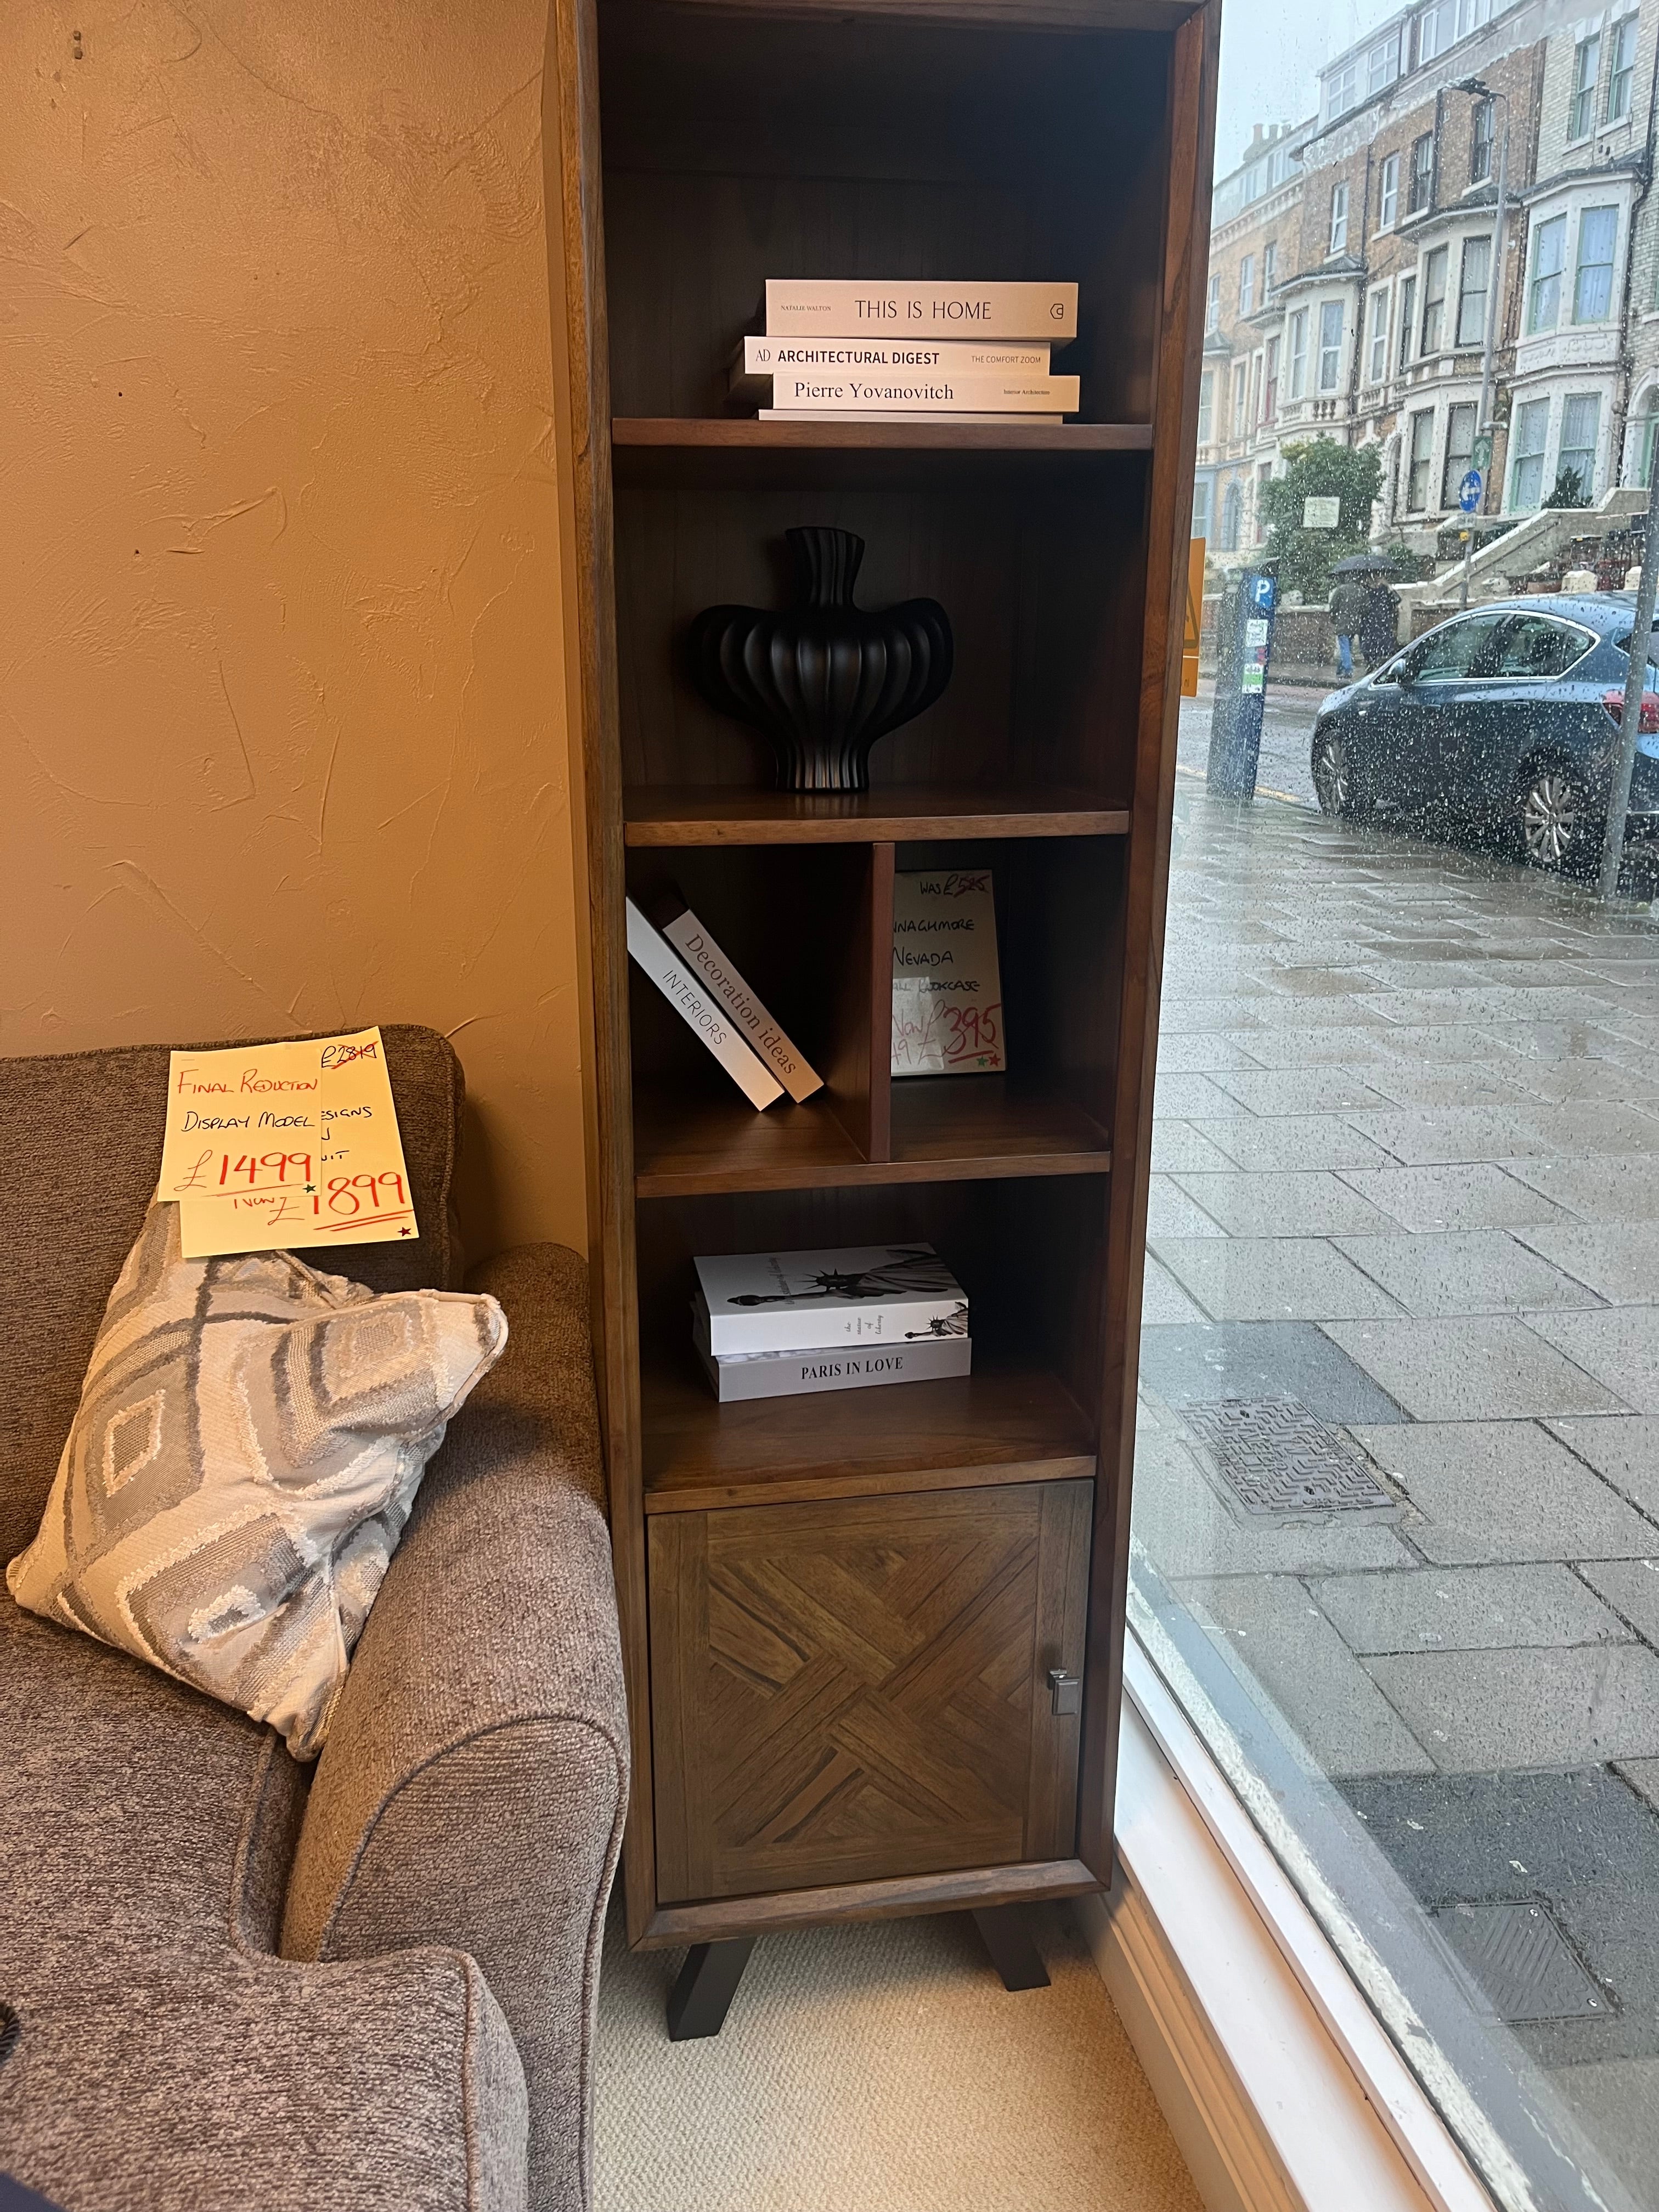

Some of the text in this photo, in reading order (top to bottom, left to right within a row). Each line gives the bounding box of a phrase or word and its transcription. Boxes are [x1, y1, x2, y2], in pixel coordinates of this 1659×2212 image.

[855, 300, 991, 319] THIS IS HOME
[756, 349, 939, 365] AD ARCHITECTURAL DIGEST
[794, 382, 953, 400] Pierre Yovanovitch
[1255, 579, 1271, 602] P
[920, 881, 941, 895] WAS
[893, 946, 954, 966] NEVADA
[663, 970, 727, 1045] INTERIORS
[685, 934, 796, 1074] Decoration ideas
[177, 1069, 235, 1094] FINAL
[181, 1111, 316, 1132] DISPLAY MODEL
[173, 1149, 312, 1191] £1499
[801, 1357, 904, 1379] PARIS IN LOVE
